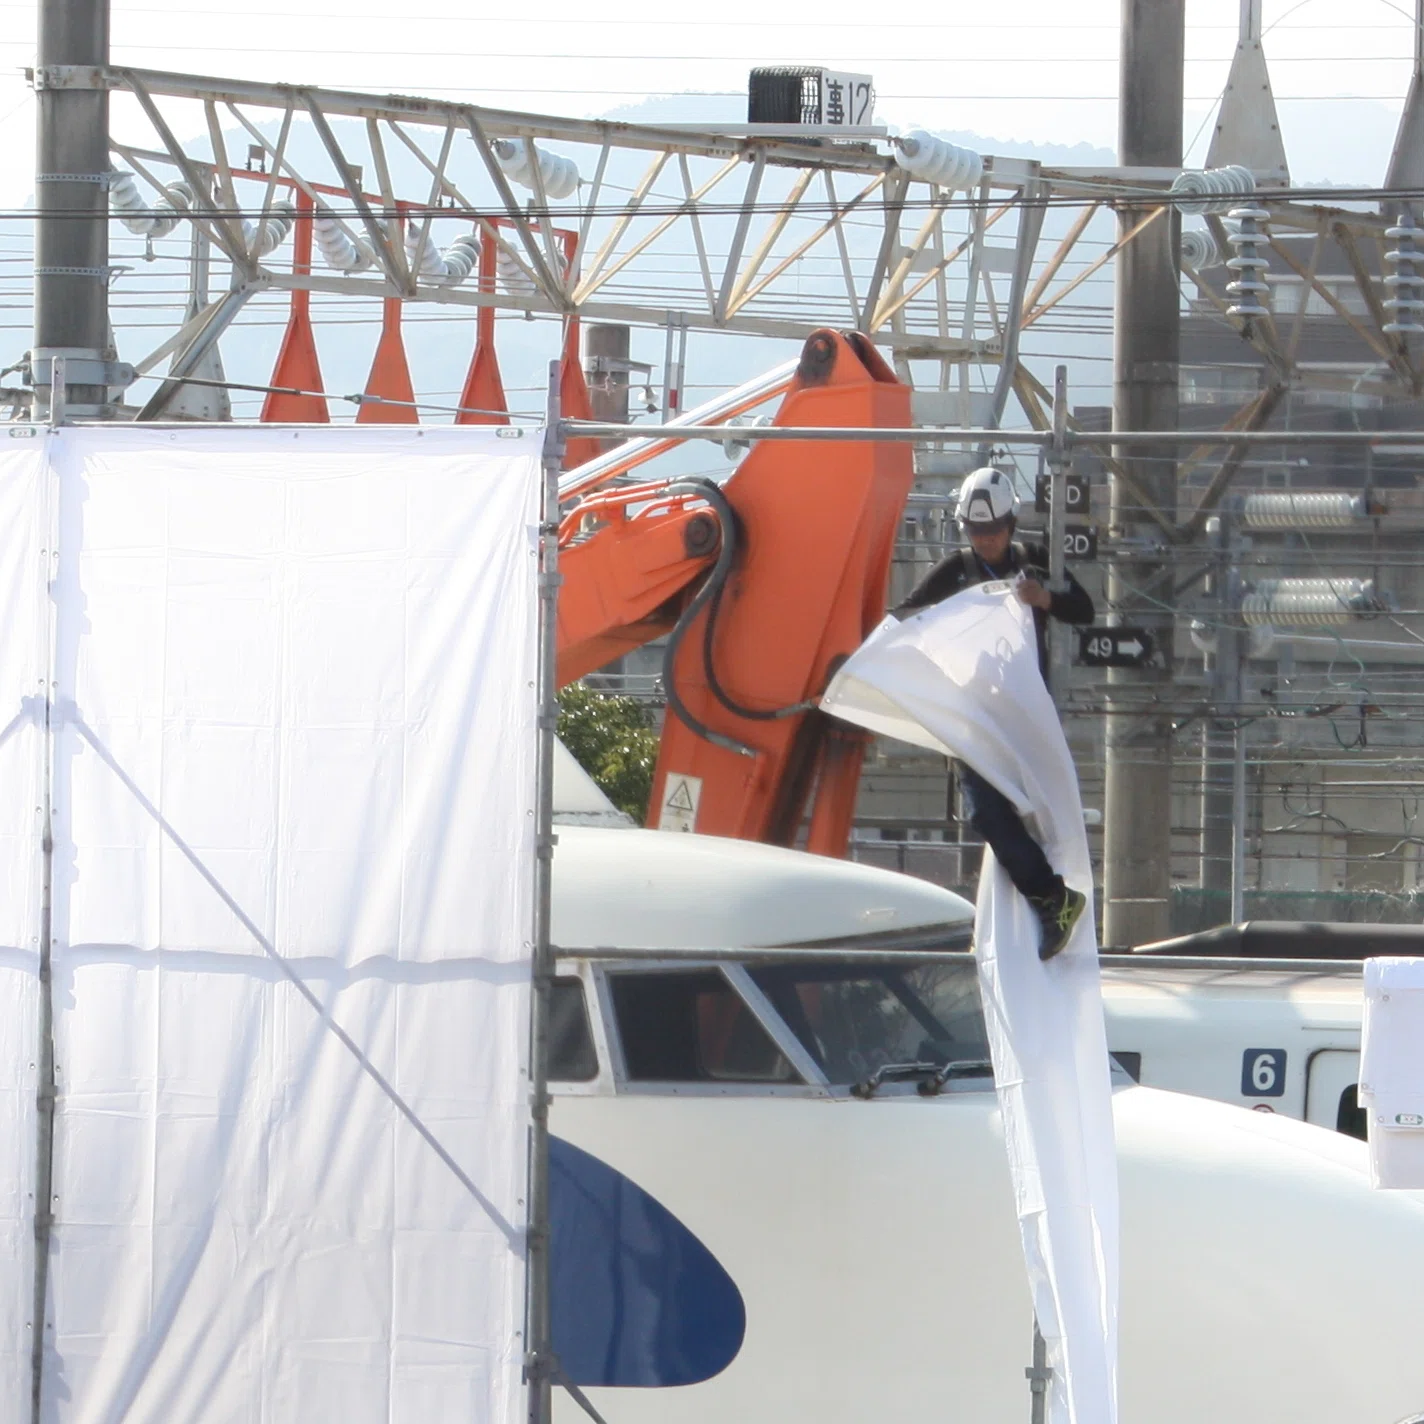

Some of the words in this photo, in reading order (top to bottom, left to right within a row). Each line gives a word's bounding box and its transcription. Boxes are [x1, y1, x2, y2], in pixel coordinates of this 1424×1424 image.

[1043, 483, 1082, 505] 3D
[1062, 533, 1090, 555] 2D
[1086, 635, 1114, 659] 49
[1252, 1053, 1276, 1091] 6
